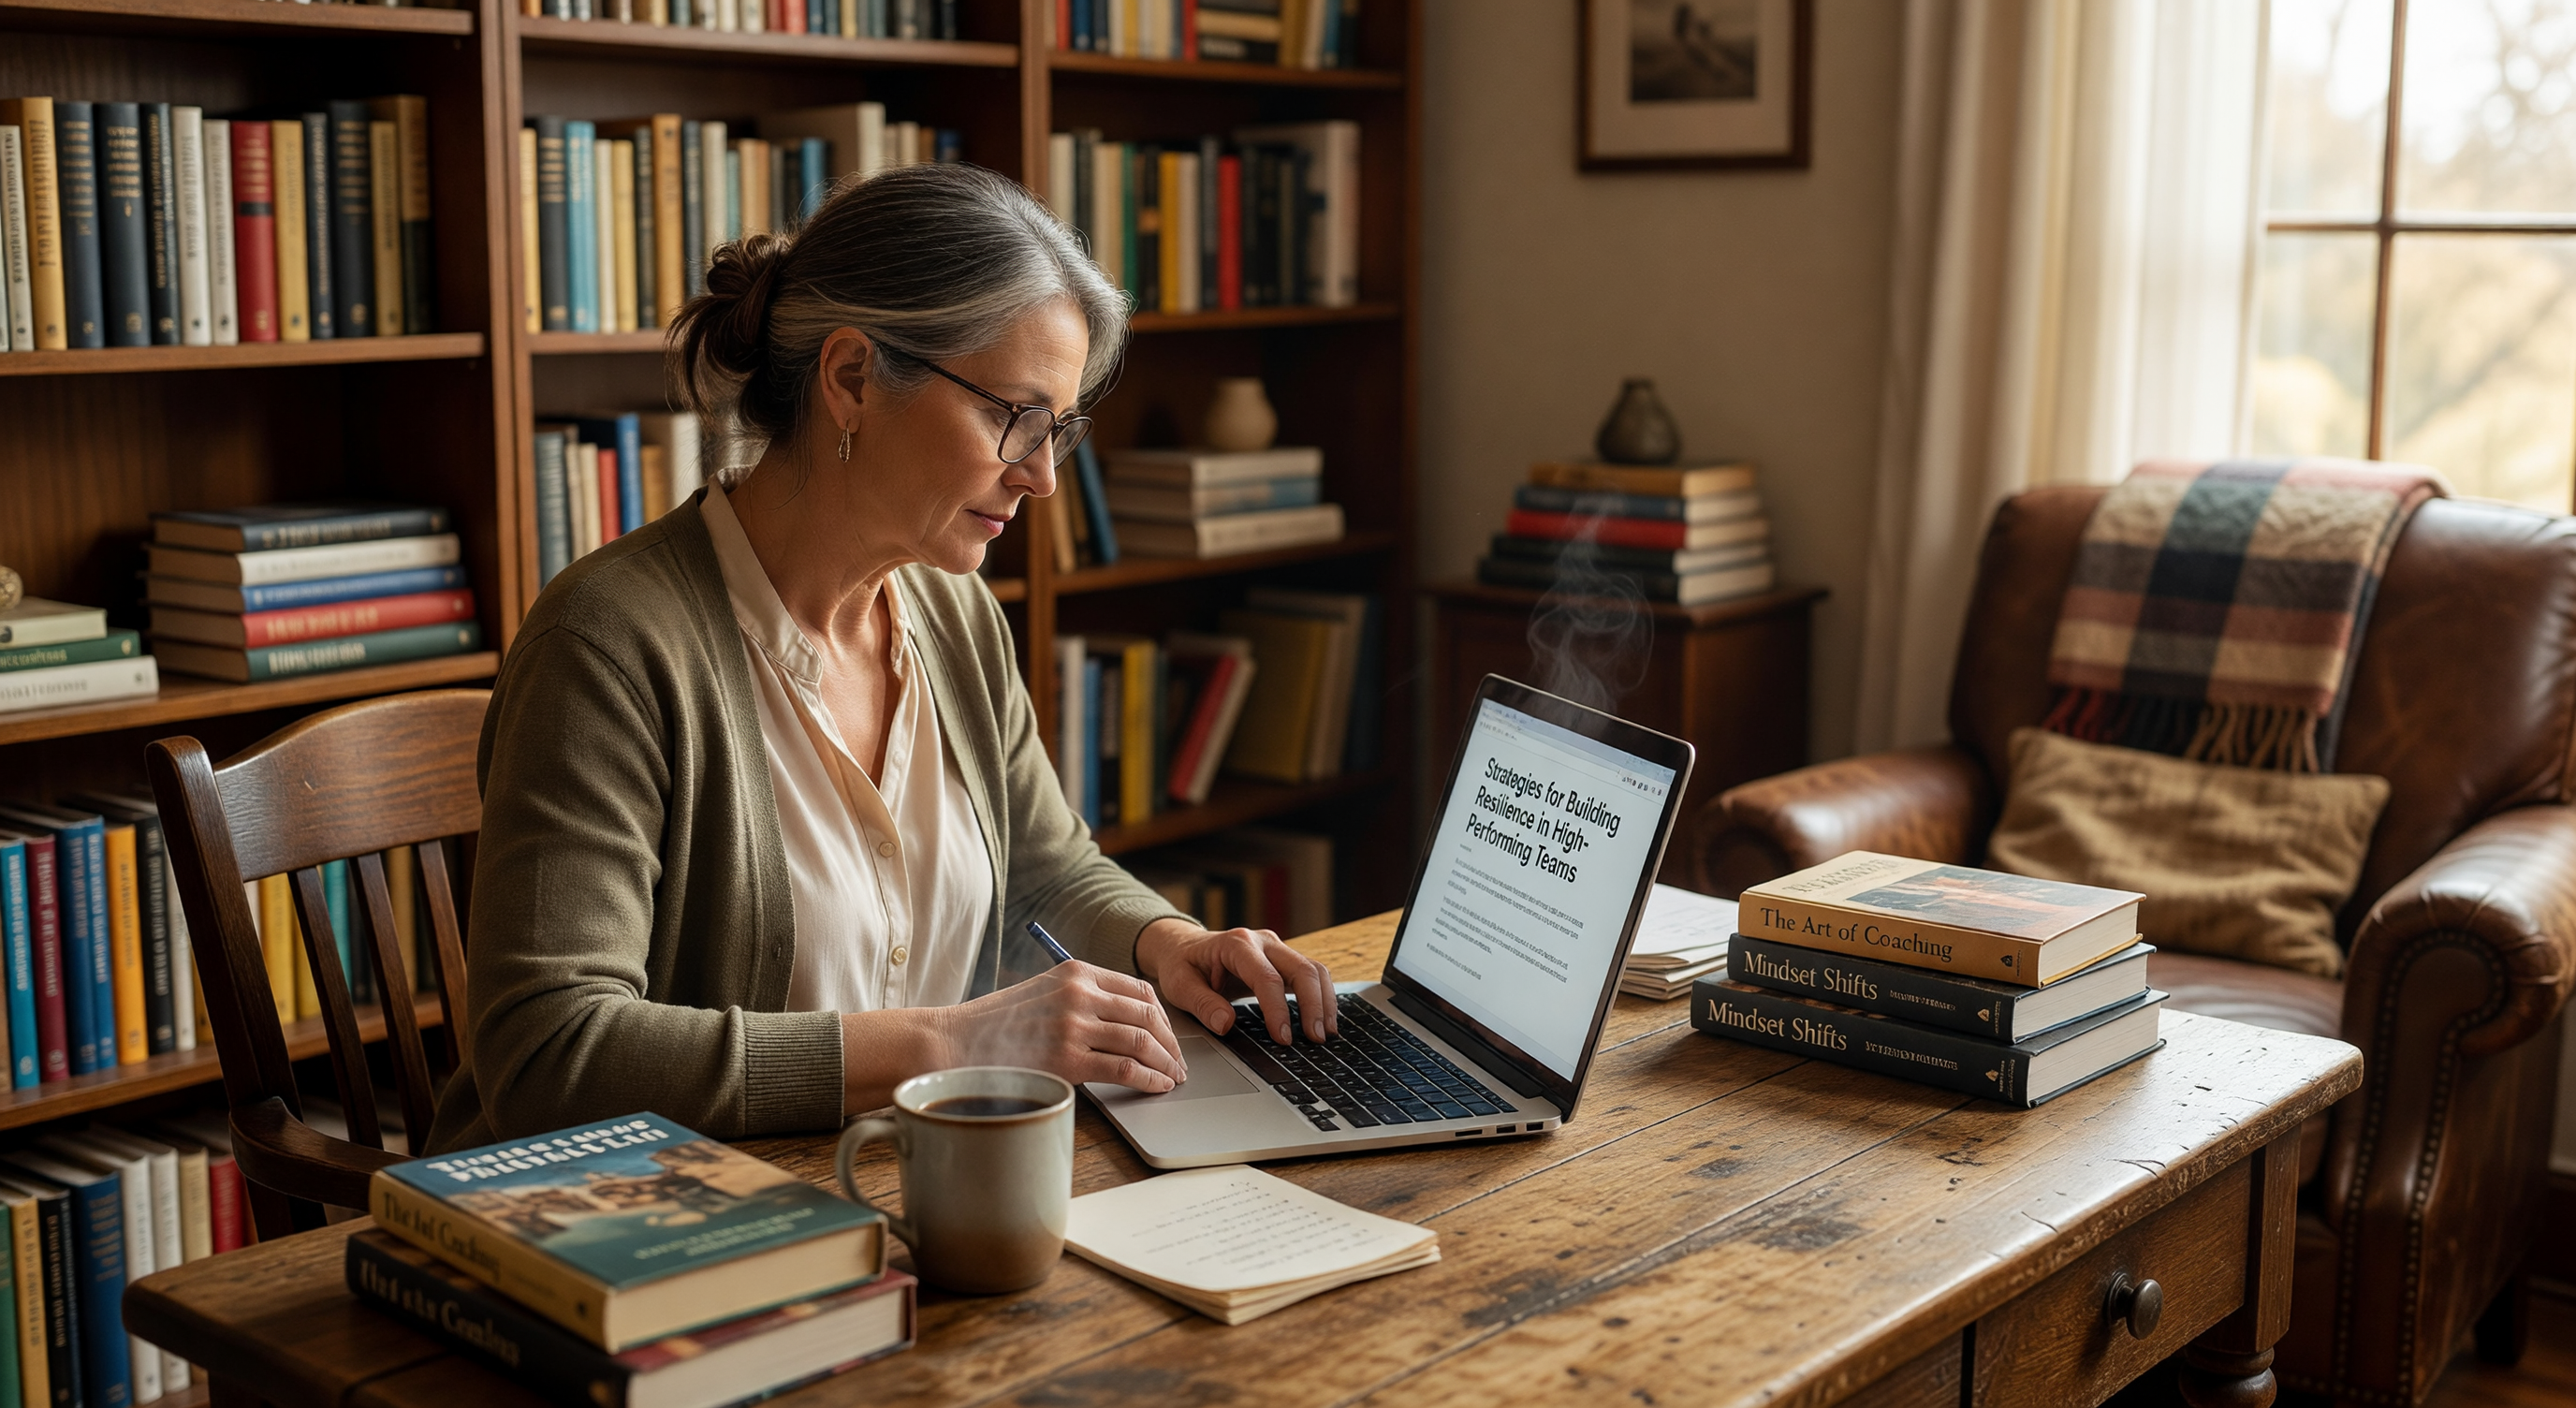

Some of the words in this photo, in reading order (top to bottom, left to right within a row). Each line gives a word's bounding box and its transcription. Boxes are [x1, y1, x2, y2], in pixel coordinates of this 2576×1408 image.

[1474, 785, 1535, 829] Resilience
[1536, 811, 1550, 837] in
[1551, 818, 1589, 854] High-
[1485, 756, 1544, 799] Strategies
[1544, 781, 1565, 808] for
[1565, 790, 1621, 838] Building
[1465, 813, 1532, 867] Performing
[1535, 843, 1577, 883] Teams
[1760, 907, 1795, 931] The
[1801, 916, 1832, 937] Art
[1838, 923, 1858, 942] of
[1864, 925, 1953, 963] Coaching
[1744, 950, 1817, 988] Mindset
[1822, 967, 1878, 1000] Shifts
[1707, 999, 1785, 1037] Mindset
[1791, 1017, 1847, 1051] Shifts
